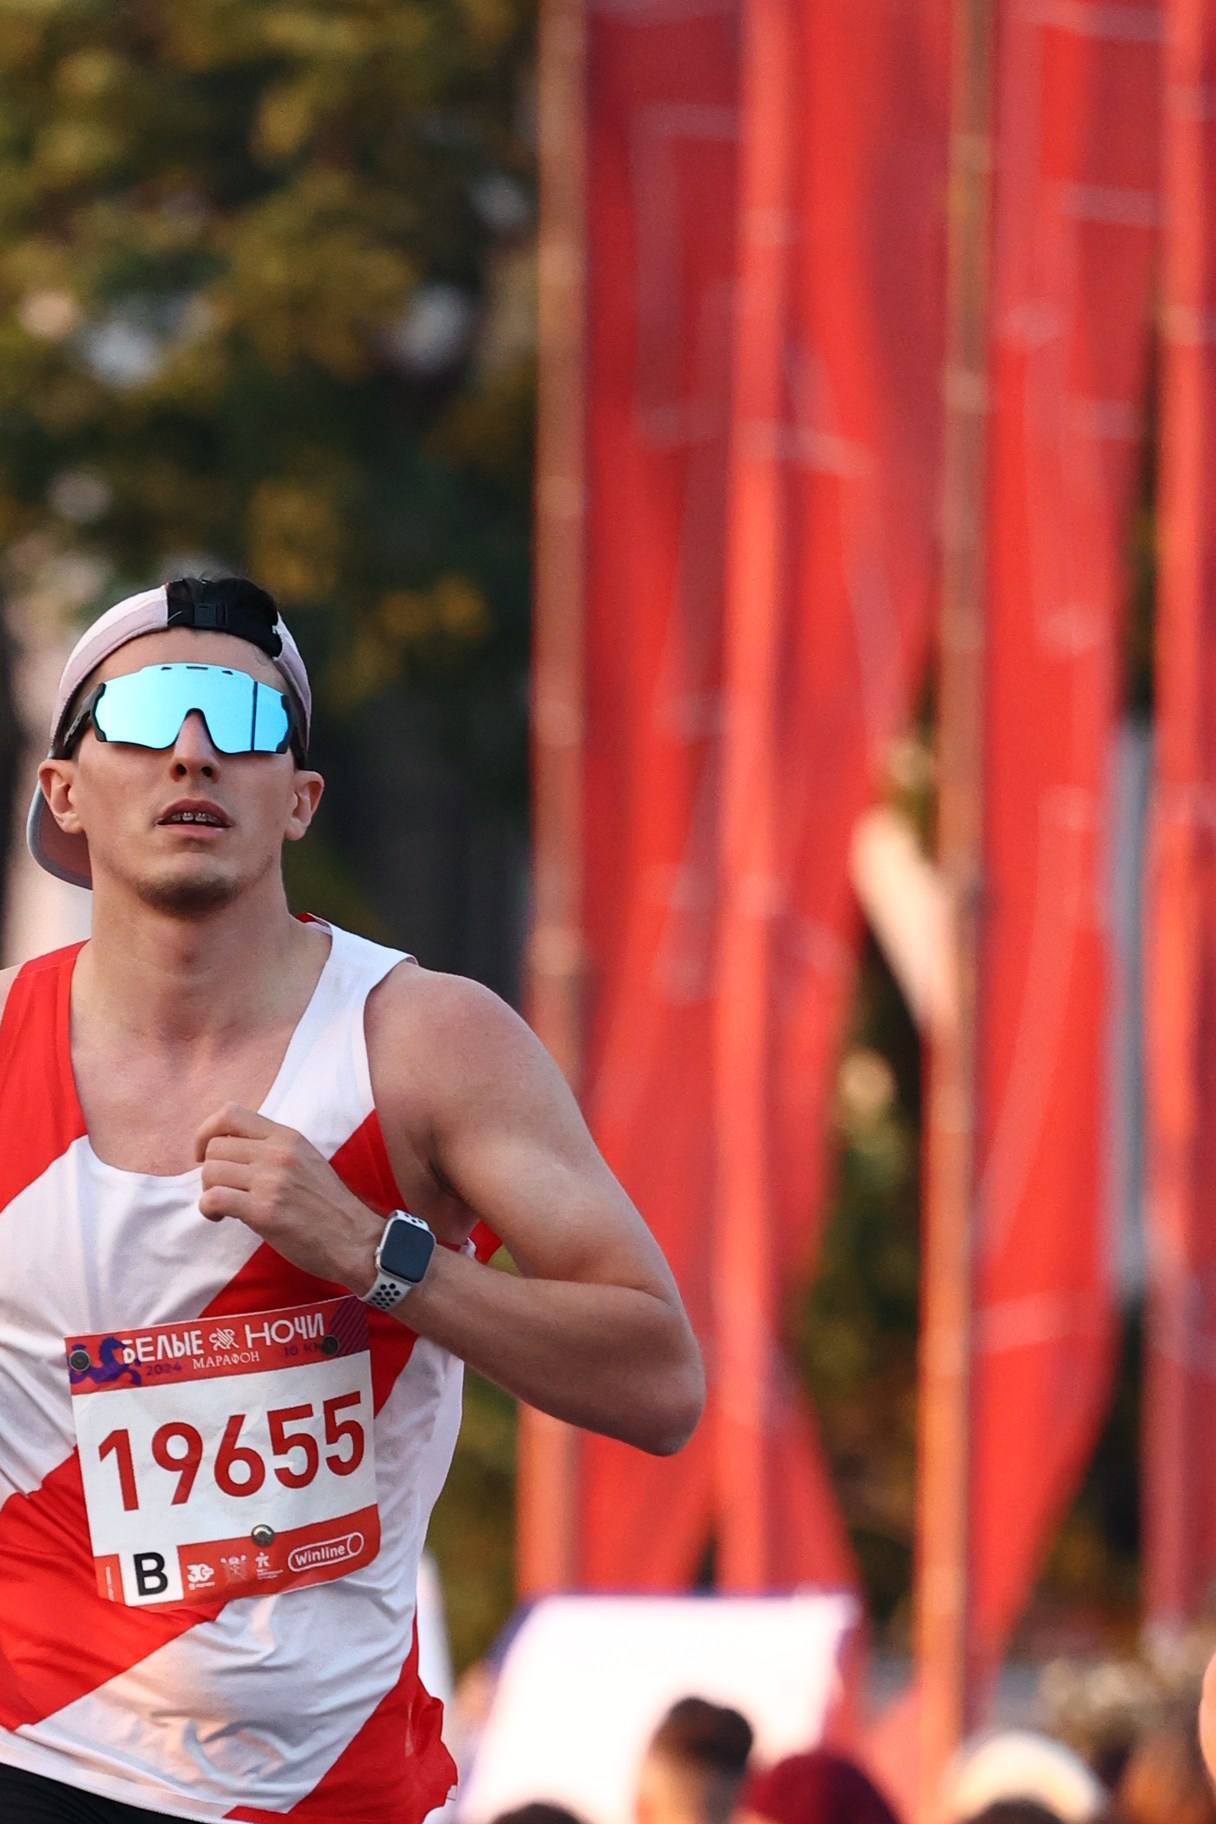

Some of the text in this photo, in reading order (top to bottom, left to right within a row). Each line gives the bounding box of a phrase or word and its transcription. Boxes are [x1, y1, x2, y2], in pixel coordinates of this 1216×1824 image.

[121, 1312, 325, 1365] БЕЛЫЕ НОЧИ
[146, 1363, 183, 1376] 2024
[192, 1350, 261, 1371] МАРАФОН
[97, 1390, 365, 1512] 19655
[294, 1545, 346, 1566] Winline
[132, 1551, 169, 1597] B
